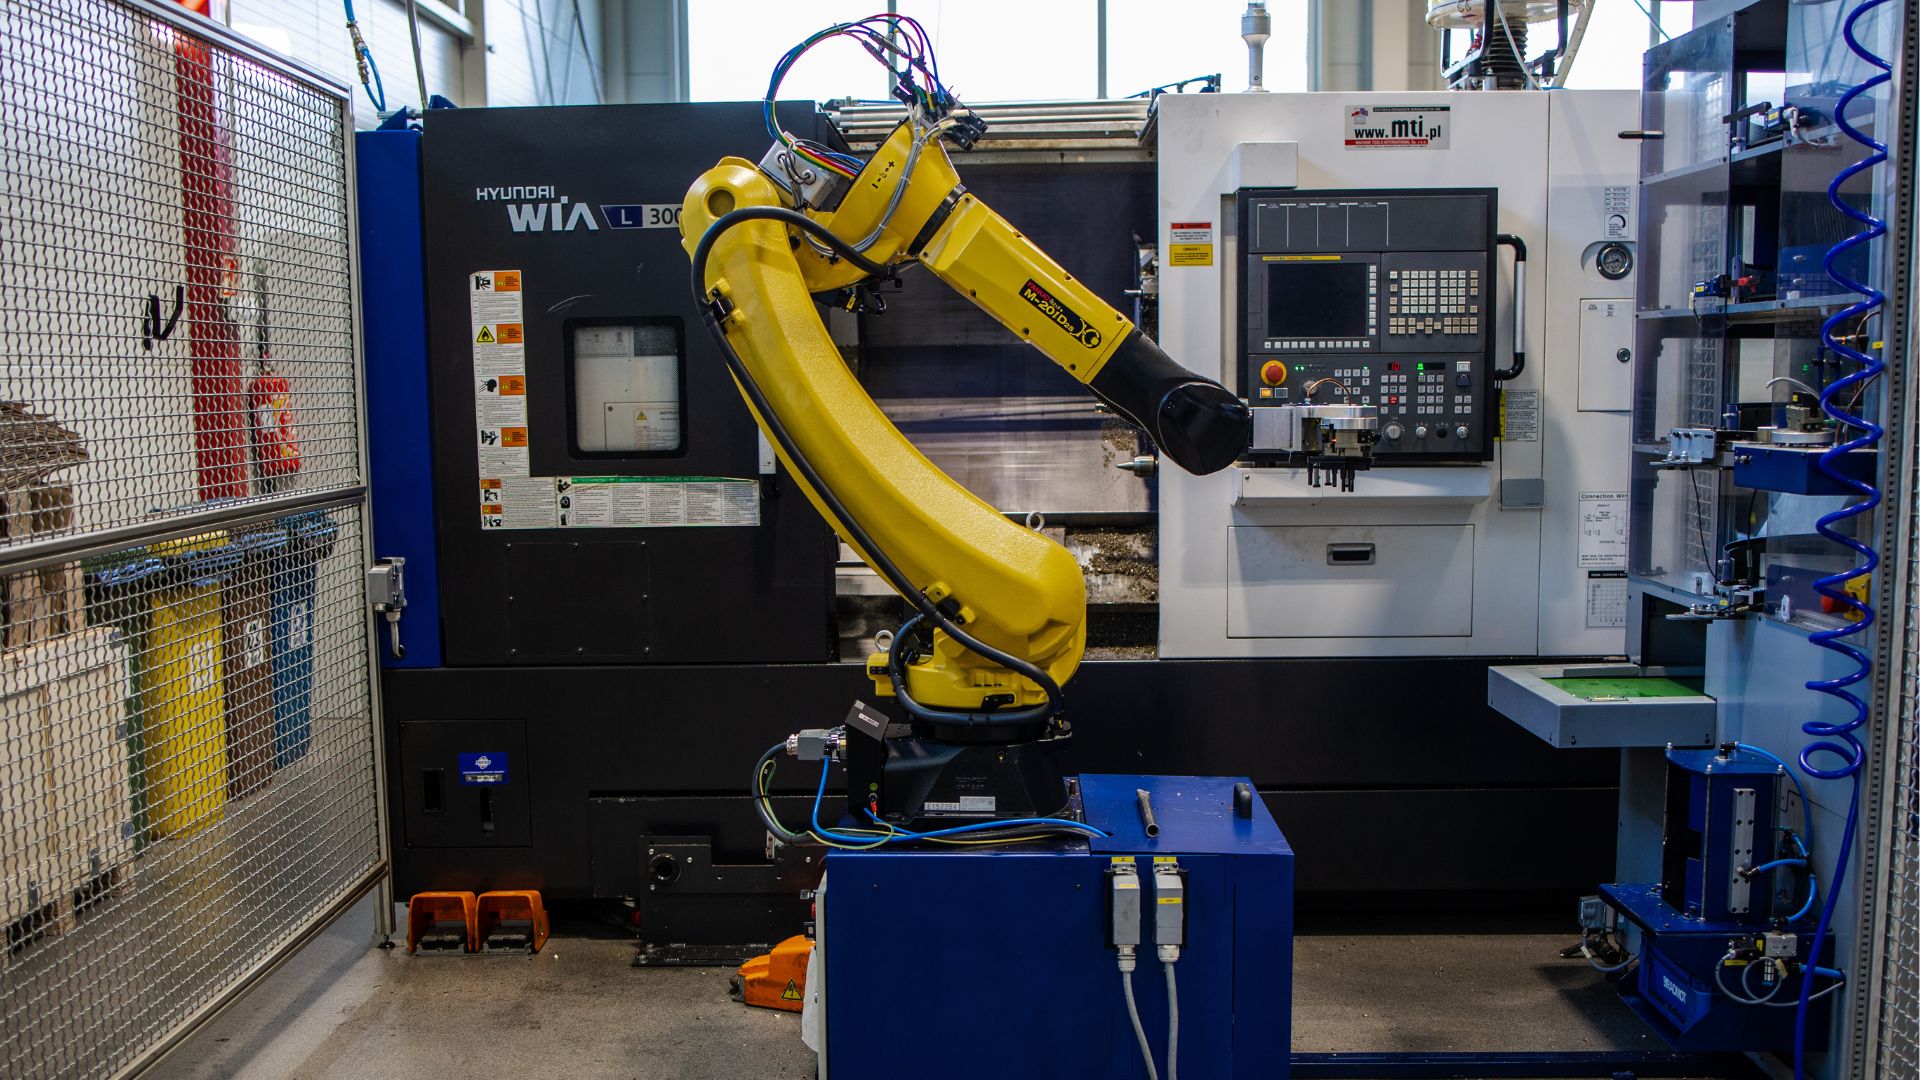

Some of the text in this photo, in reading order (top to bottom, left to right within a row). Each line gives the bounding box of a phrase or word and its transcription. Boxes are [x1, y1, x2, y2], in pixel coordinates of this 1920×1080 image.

[476, 185, 555, 200] HYUNDAI
[621, 209, 632, 225] L
[1027, 281, 1050, 301] FANUC
